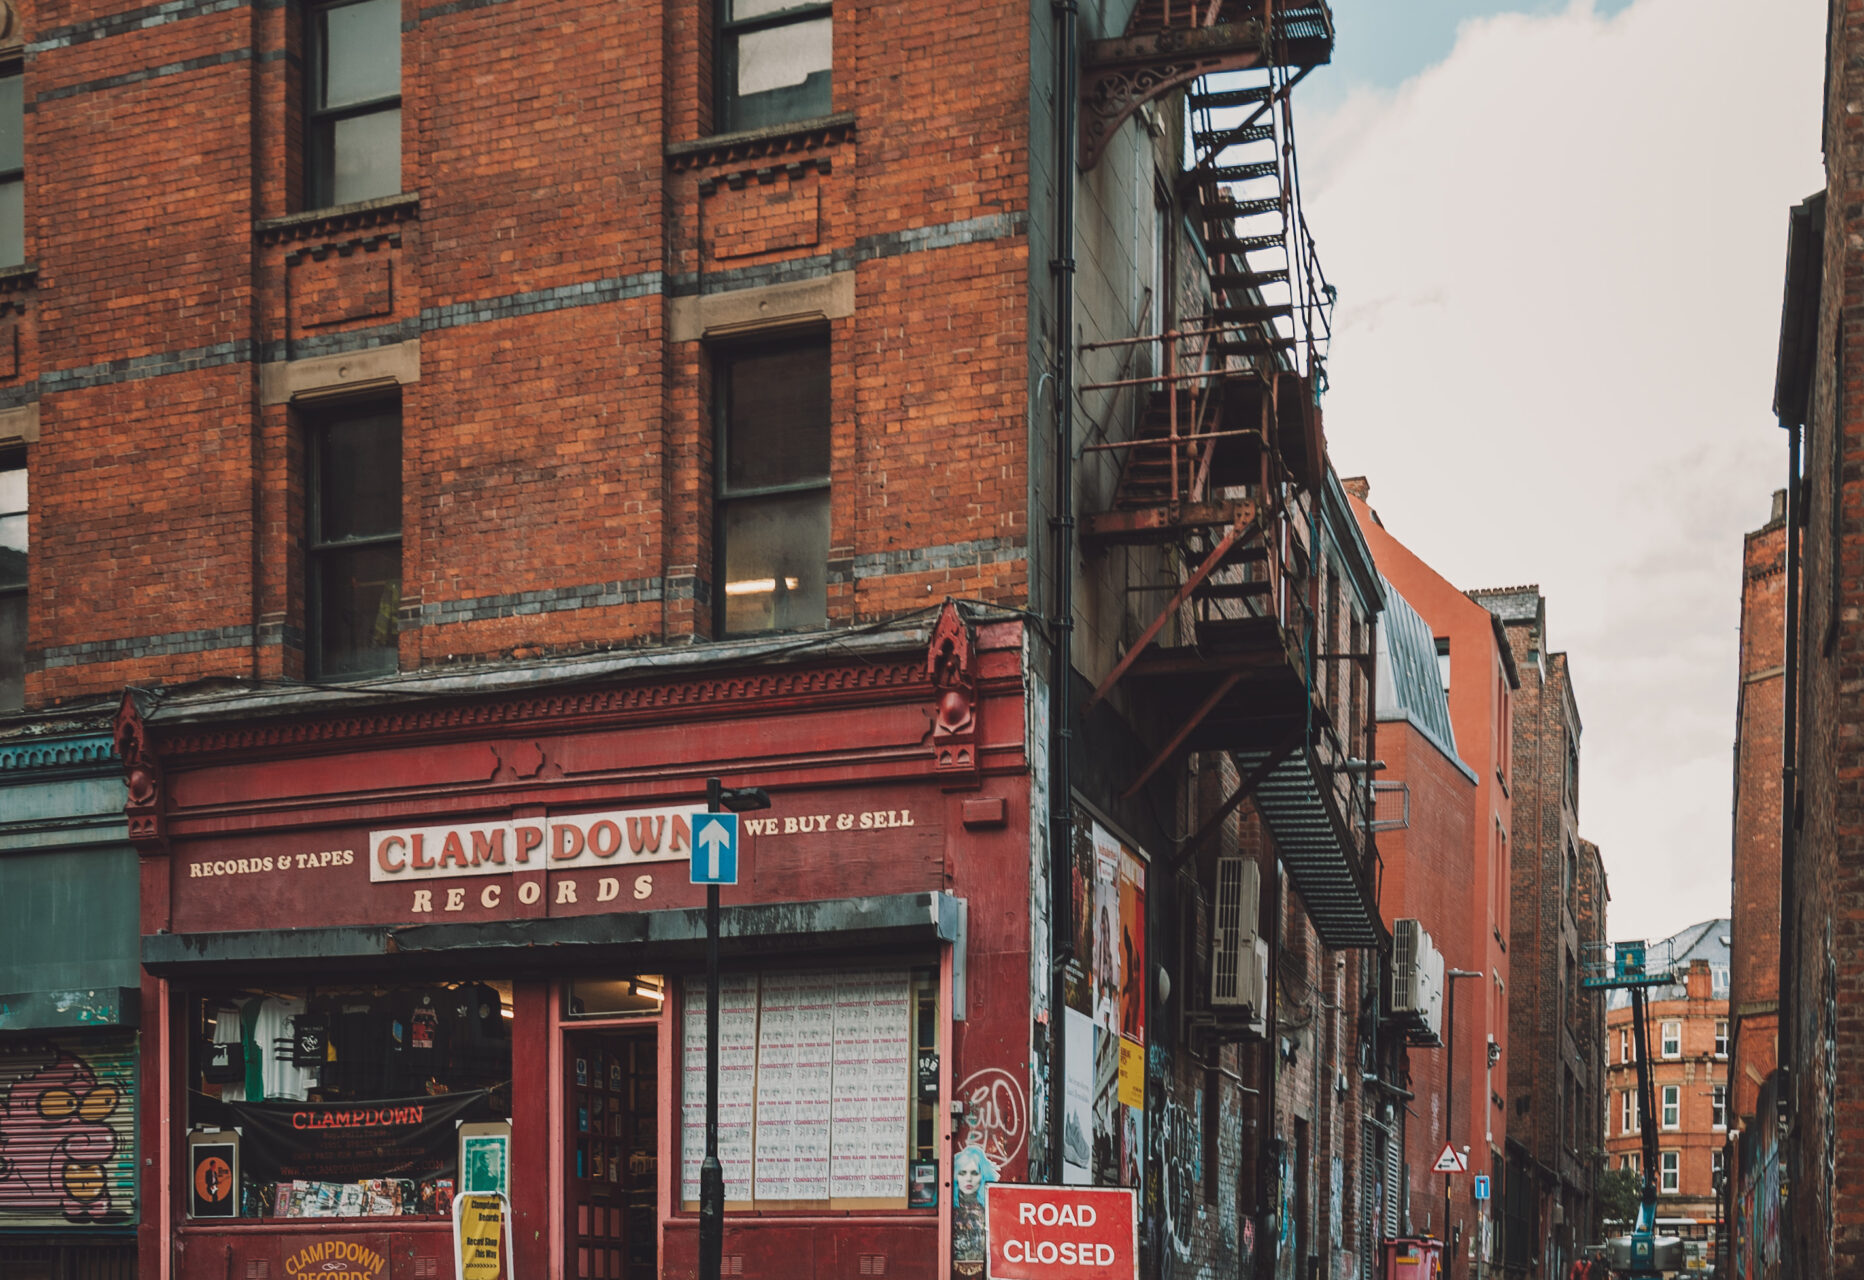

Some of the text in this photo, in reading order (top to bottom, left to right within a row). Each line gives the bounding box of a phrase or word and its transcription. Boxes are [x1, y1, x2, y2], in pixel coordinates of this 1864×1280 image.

[744, 810, 914, 836] WE BUY & SELL
[377, 815, 691, 872] CLAMPDOWN
[190, 850, 354, 878] RECORDS & TAPES
[411, 875, 653, 913] RECORDS
[292, 1105, 425, 1130] CLAMPDOWN
[1019, 1202, 1097, 1227] ROAD
[466, 1237, 497, 1247] Record Shop
[475, 1249, 485, 1258] This
[1003, 1239, 1115, 1266] CLOSED
[285, 1241, 385, 1275] CLAMPDOWN
